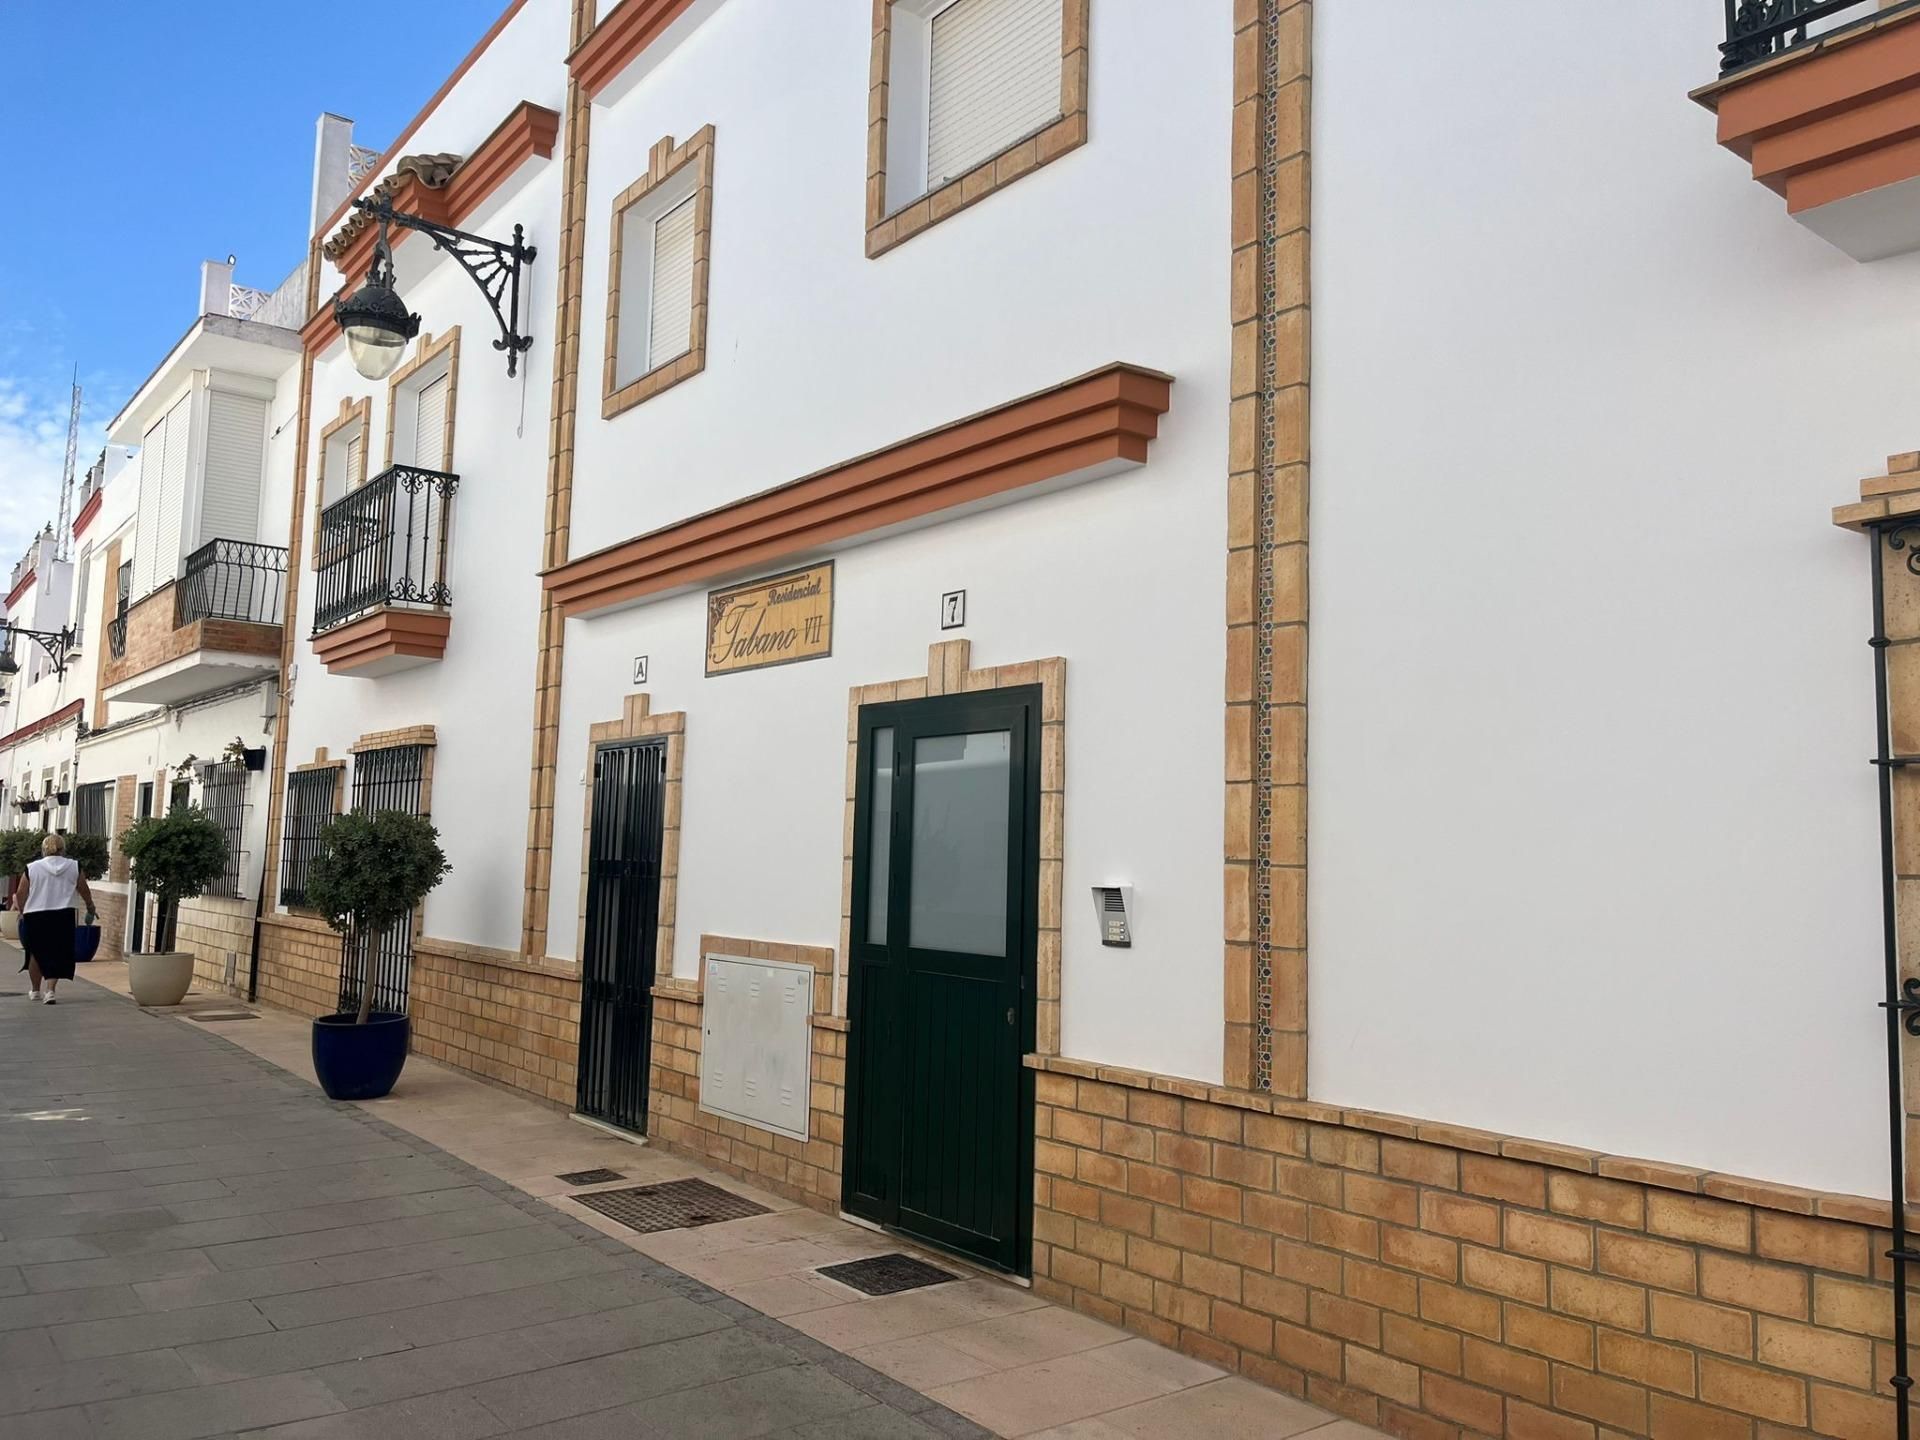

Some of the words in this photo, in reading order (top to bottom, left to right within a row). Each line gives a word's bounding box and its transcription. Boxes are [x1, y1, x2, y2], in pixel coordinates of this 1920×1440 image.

[767, 576, 821, 606] Residencial
[948, 595, 958, 623] 7
[804, 615, 823, 645] VII
[635, 661, 645, 678] A
